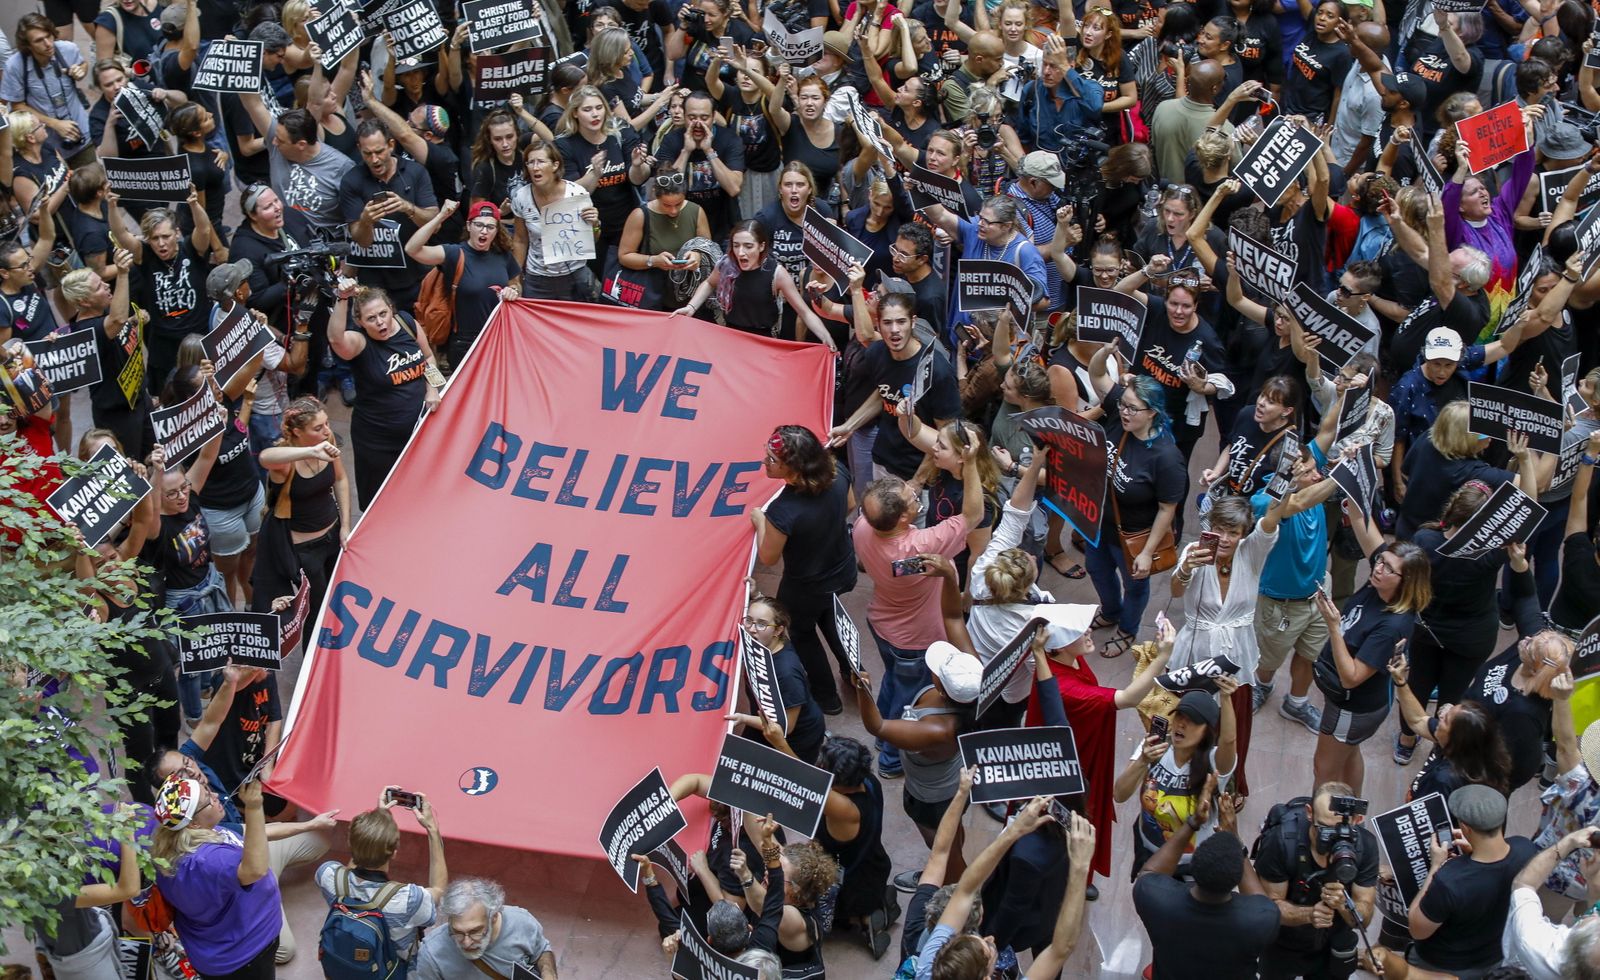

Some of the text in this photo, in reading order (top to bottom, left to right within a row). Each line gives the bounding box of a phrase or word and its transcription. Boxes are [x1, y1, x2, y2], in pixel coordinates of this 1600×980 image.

[388, 2, 429, 28] SEXUAL
[475, 9, 530, 31] BLASEY FORD
[478, 1, 524, 19] CHRISTINE
[314, 17, 330, 34] WE
[327, 21, 345, 42] NOT
[481, 26, 502, 40] 100%
[321, 26, 362, 65] BE SILENT
[404, 43, 415, 55] A
[227, 75, 260, 89] FORD
[481, 59, 545, 79] BELIEVE
[481, 73, 544, 89] SURVIVORS
[1476, 115, 1514, 140] BELIEVE
[107, 168, 189, 181] KAVANAUGH WAS A
[1263, 138, 1307, 189] OF LIES
[1244, 171, 1258, 188] A
[773, 240, 803, 252] Favo
[804, 220, 839, 254] KAVANAUGH
[1229, 233, 1292, 286] NEVER
[153, 266, 190, 291] BE A
[960, 272, 991, 285] BRETT
[966, 285, 1007, 297] DEFINES
[1235, 258, 1288, 301] AGAIN
[26, 292, 41, 323] RESIST
[156, 286, 197, 311] HERO
[215, 312, 251, 355] KAVANAUGH
[1078, 314, 1100, 330] LIED
[1289, 292, 1365, 356] BEWARE
[213, 355, 227, 374] IED
[226, 337, 248, 368] UNDER
[390, 361, 426, 386] WOME
[601, 347, 712, 421] WE
[1142, 354, 1182, 389] WOMEN
[1470, 397, 1563, 430] SEXUAL PREDATORS
[1473, 407, 1559, 440] MUST BE STOPPED
[1024, 416, 1098, 448] WOMEN
[464, 420, 764, 518] BELIEVE
[1551, 465, 1579, 488] BLAS
[81, 508, 99, 528] IS
[1478, 490, 1527, 541] KAVANAUGH
[1500, 506, 1532, 541] HUBRIS
[495, 542, 631, 614] ALL
[182, 645, 280, 662] IS 100% CERTAIN
[190, 633, 270, 650] BLASEY FORD
[317, 580, 735, 716] SURVIVORS
[753, 647, 768, 681] HILL
[976, 741, 1063, 765] KAVANAUGH
[720, 754, 825, 806] THE FBI INVESTIGATION
[984, 759, 1079, 784] BELLIGERENT
[730, 772, 805, 810] IS A WHITEWASH
[607, 785, 669, 866] KAVANAUGH WAS A
[642, 797, 678, 832] DRUNK
[1411, 800, 1435, 836] BRETT
[1395, 814, 1422, 859] DEFINES
